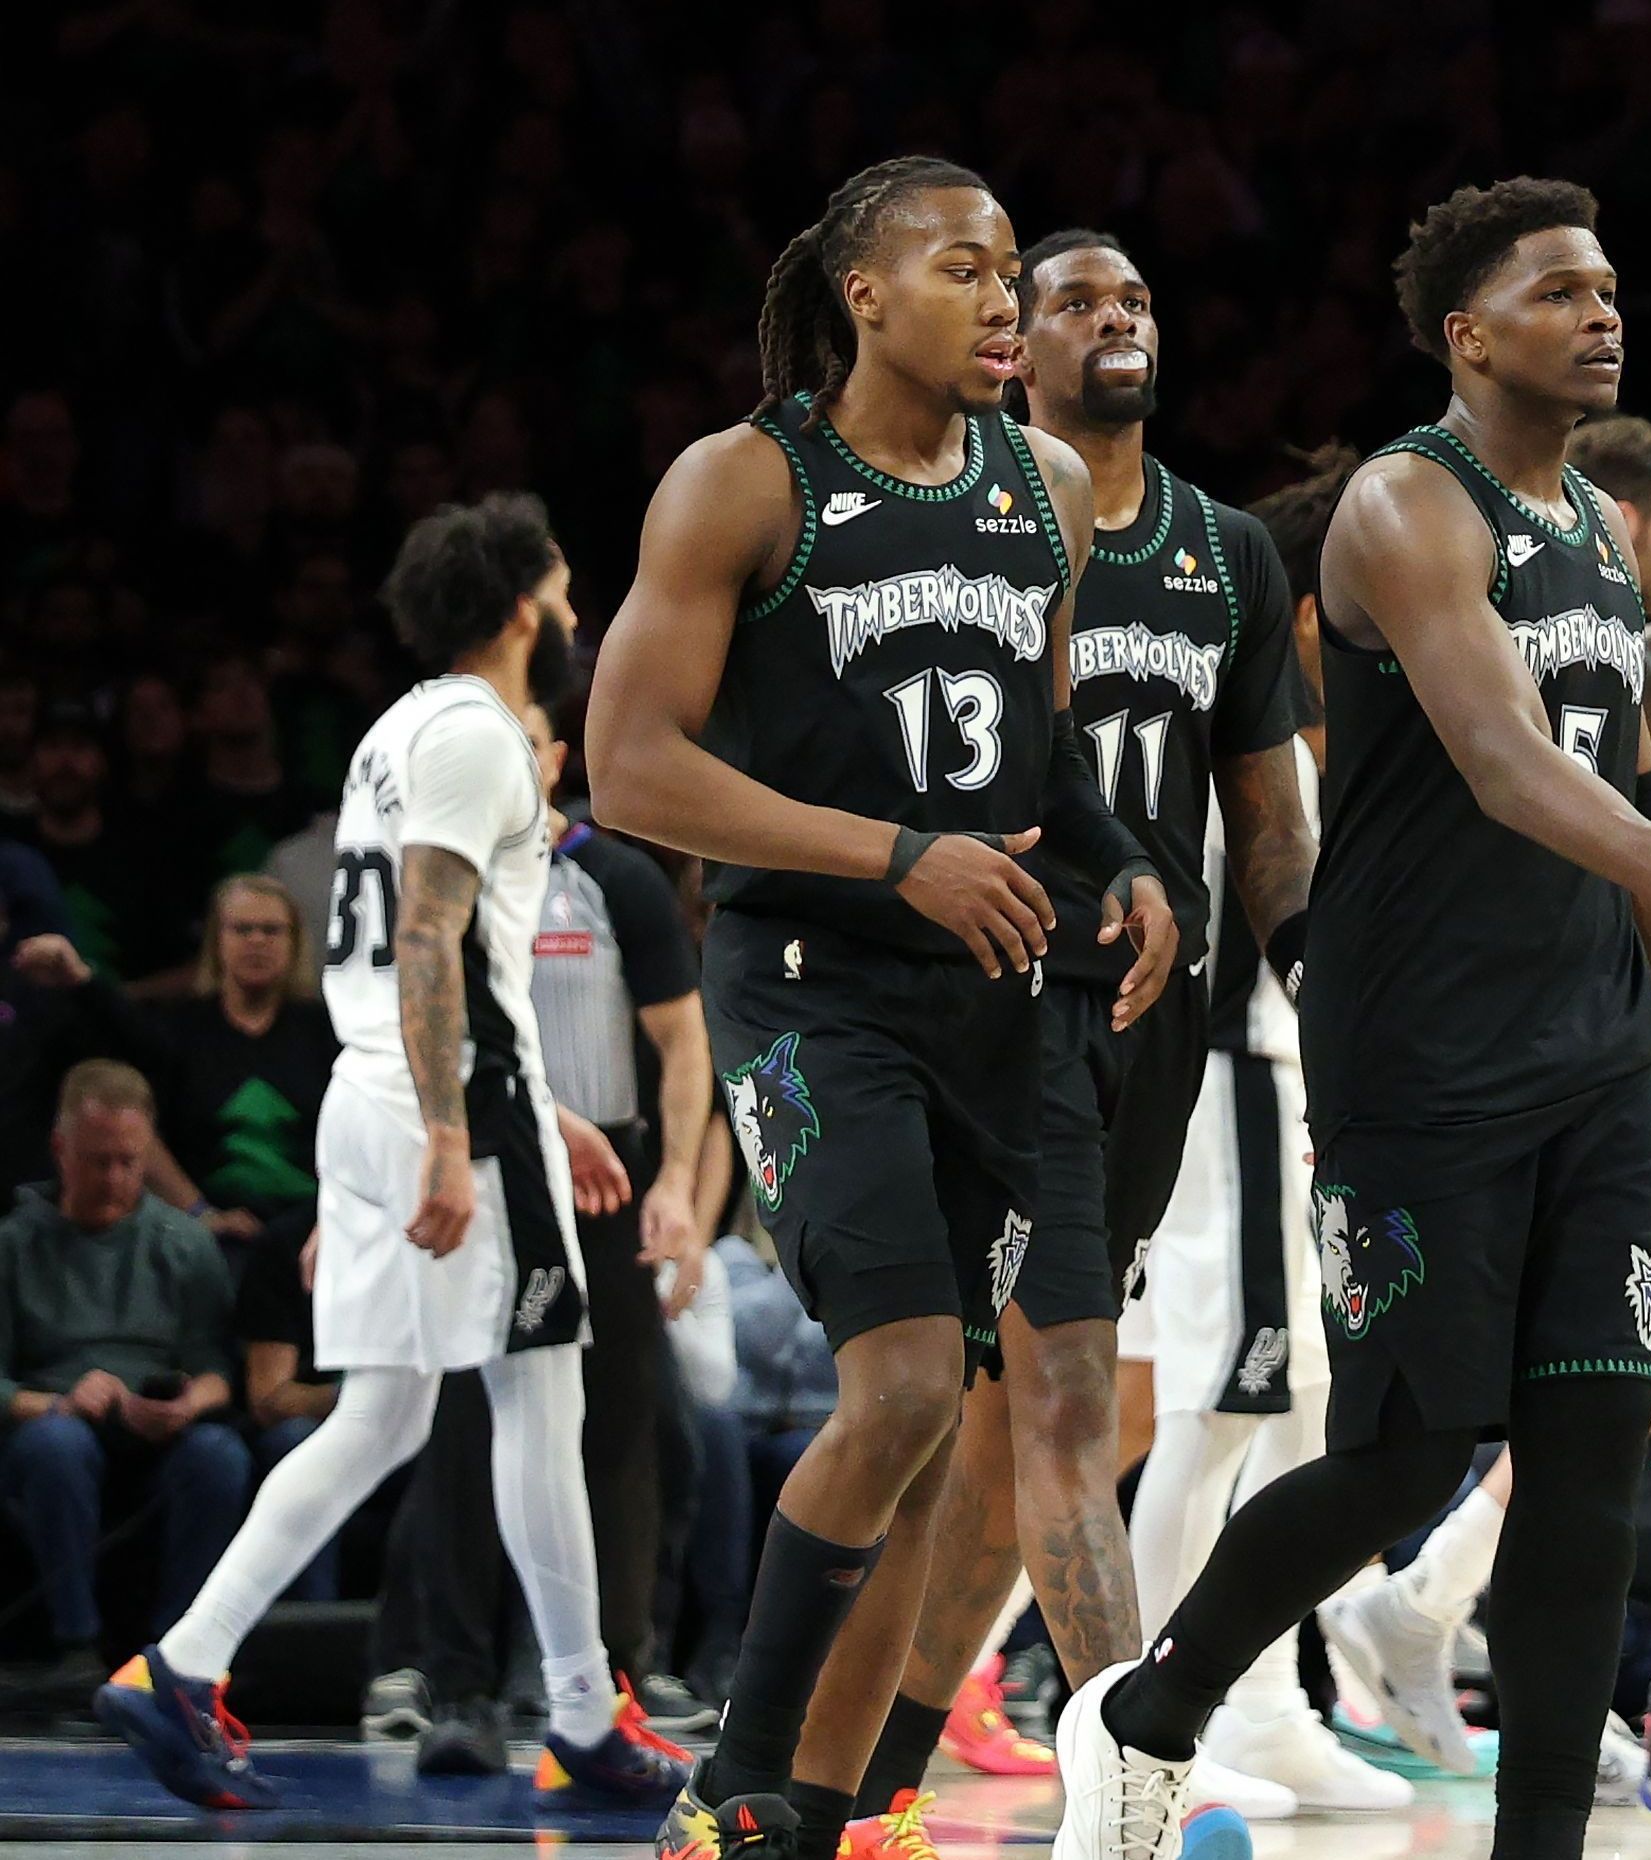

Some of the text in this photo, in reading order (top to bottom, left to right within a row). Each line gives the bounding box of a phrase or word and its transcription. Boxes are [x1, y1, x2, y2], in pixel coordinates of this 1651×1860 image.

[830, 493, 866, 511] NIKE
[975, 515, 1038, 535] sezzle
[805, 563, 1059, 680] TIMBERWOLVES
[1163, 574, 1219, 594] sezzle
[1069, 621, 1227, 712] BERWOLVES
[882, 666, 1004, 793] 13
[1083, 708, 1173, 820] 11
